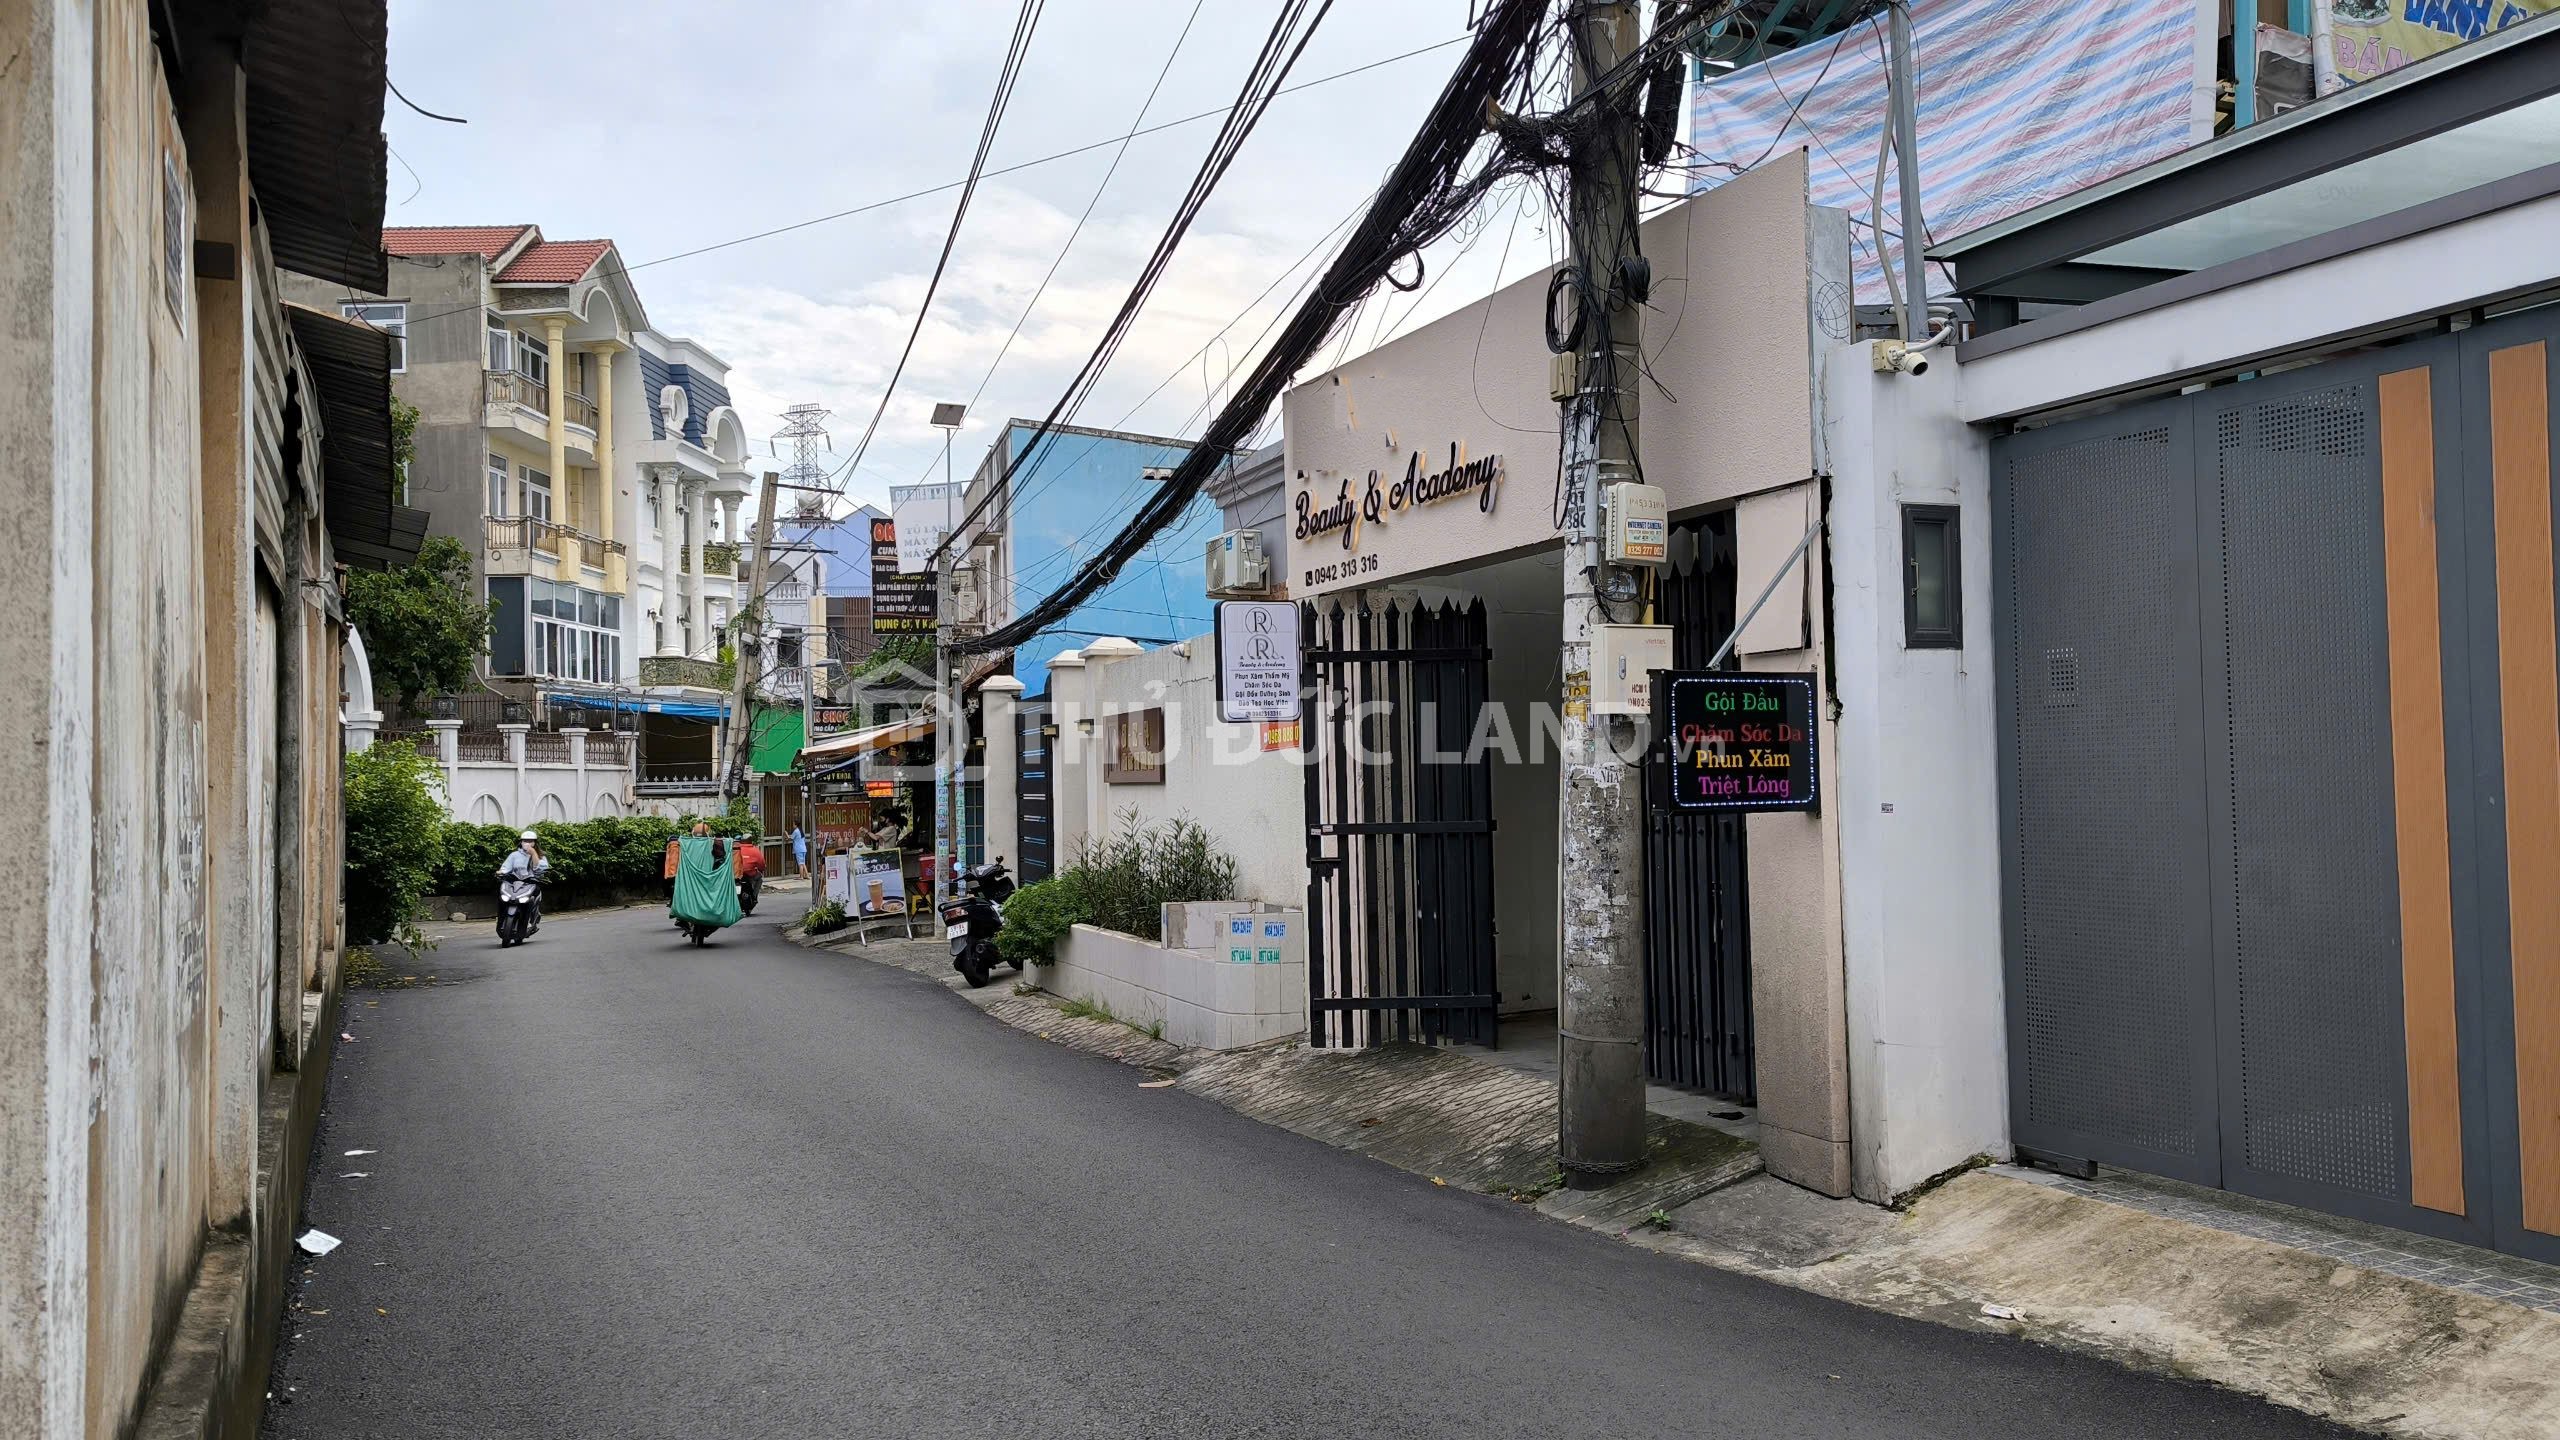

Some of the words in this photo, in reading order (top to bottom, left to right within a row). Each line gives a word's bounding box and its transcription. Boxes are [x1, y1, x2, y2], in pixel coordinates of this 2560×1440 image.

[1296, 479, 1357, 550] Beauty
[1364, 469, 1381, 524] &
[1389, 441, 1497, 513] Academy
[1315, 564, 1337, 585] 0942
[1341, 557, 1357, 578] 313
[1361, 553, 1378, 574] 316
[1705, 691, 1735, 715] Gội
[1743, 687, 1778, 710] Đầu
[1682, 724, 1736, 742] Chăm
[1741, 723, 1772, 742] Sóc
[1778, 723, 1803, 742] Da
[1696, 750, 1743, 768] Phun
[1750, 748, 1790, 767] Xăm
[1698, 774, 1741, 799] Triệt
[1747, 774, 1790, 797] Lông
